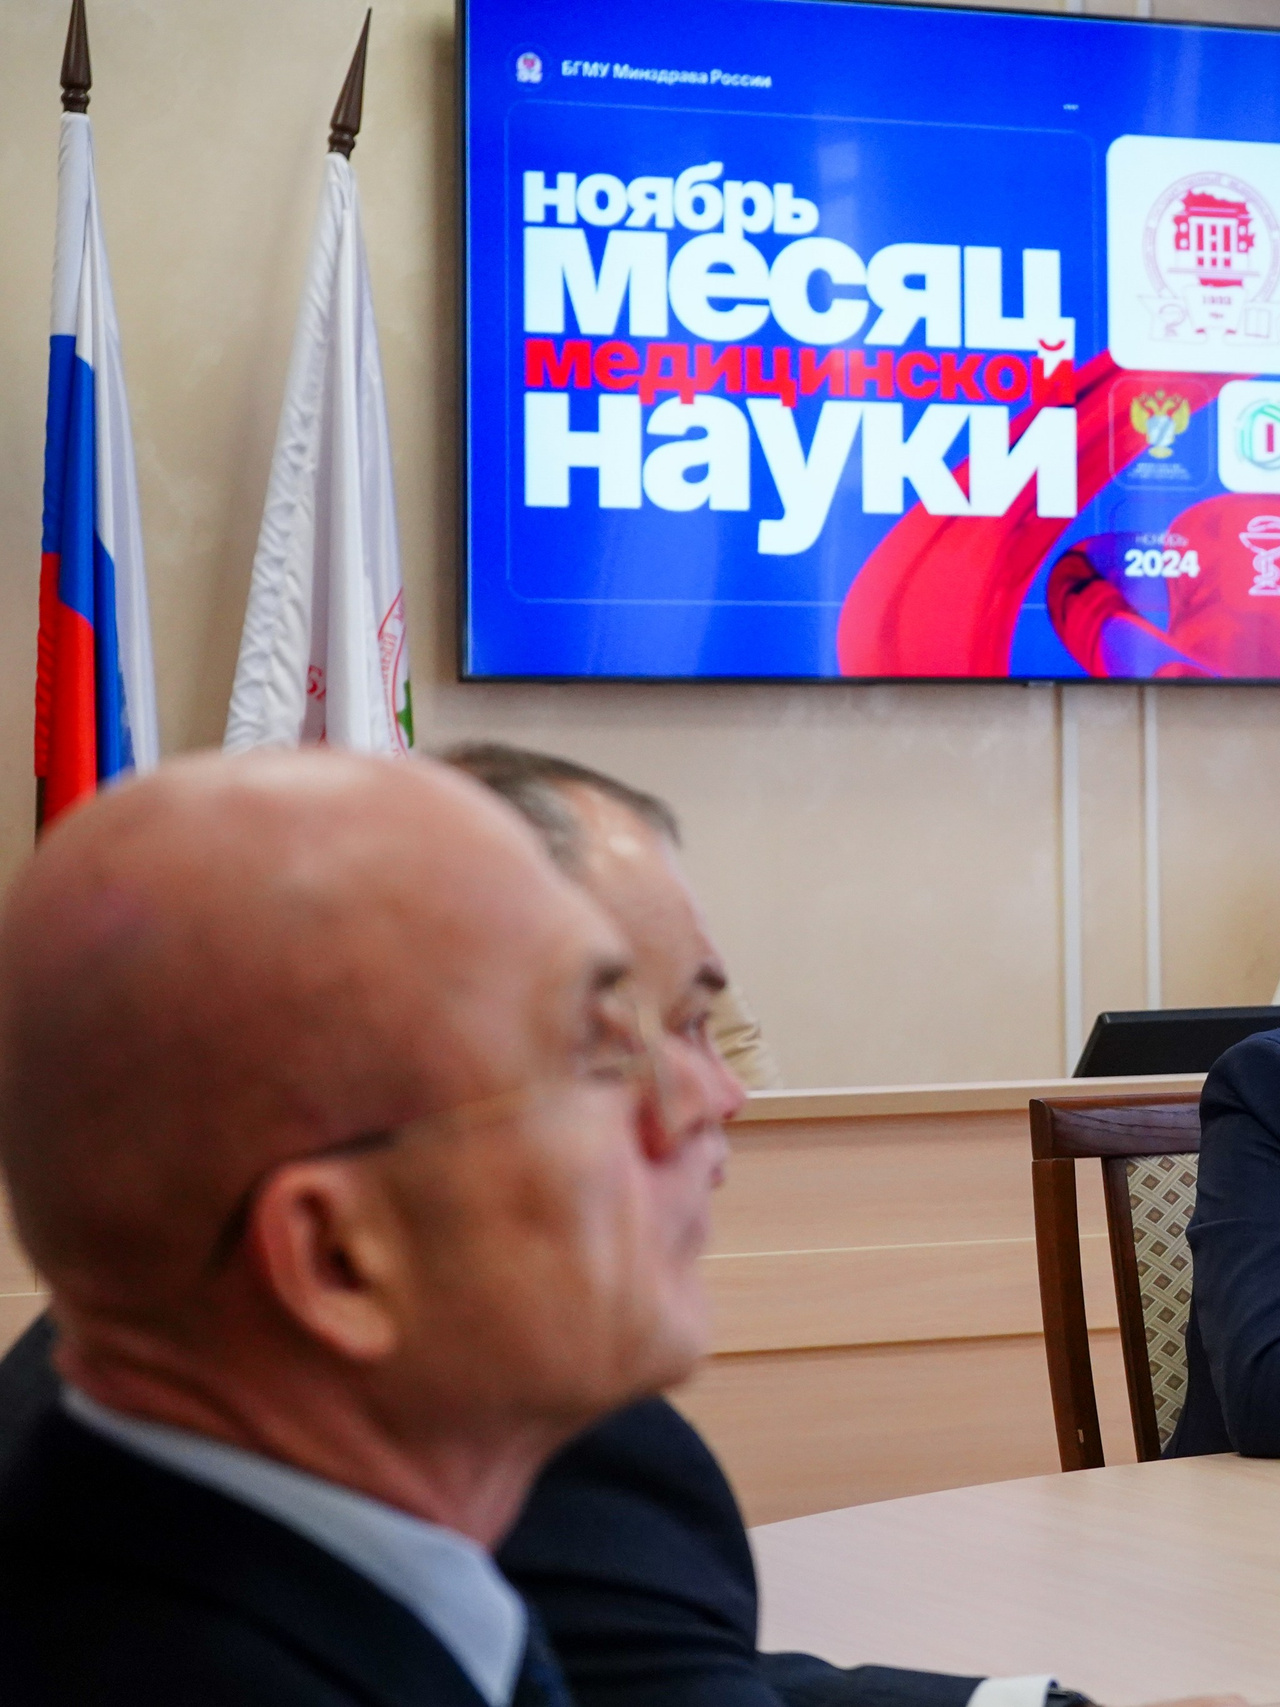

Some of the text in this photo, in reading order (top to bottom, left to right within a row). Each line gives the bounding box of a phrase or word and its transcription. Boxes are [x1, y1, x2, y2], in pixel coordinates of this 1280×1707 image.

[561, 60, 772, 88] БГМУ Минздрава России
[523, 161, 819, 237] ноябрь
[523, 227, 1076, 378] месяц
[523, 339, 1077, 407] медицинской
[524, 392, 1077, 554] науки
[1124, 548, 1200, 578] 2024
